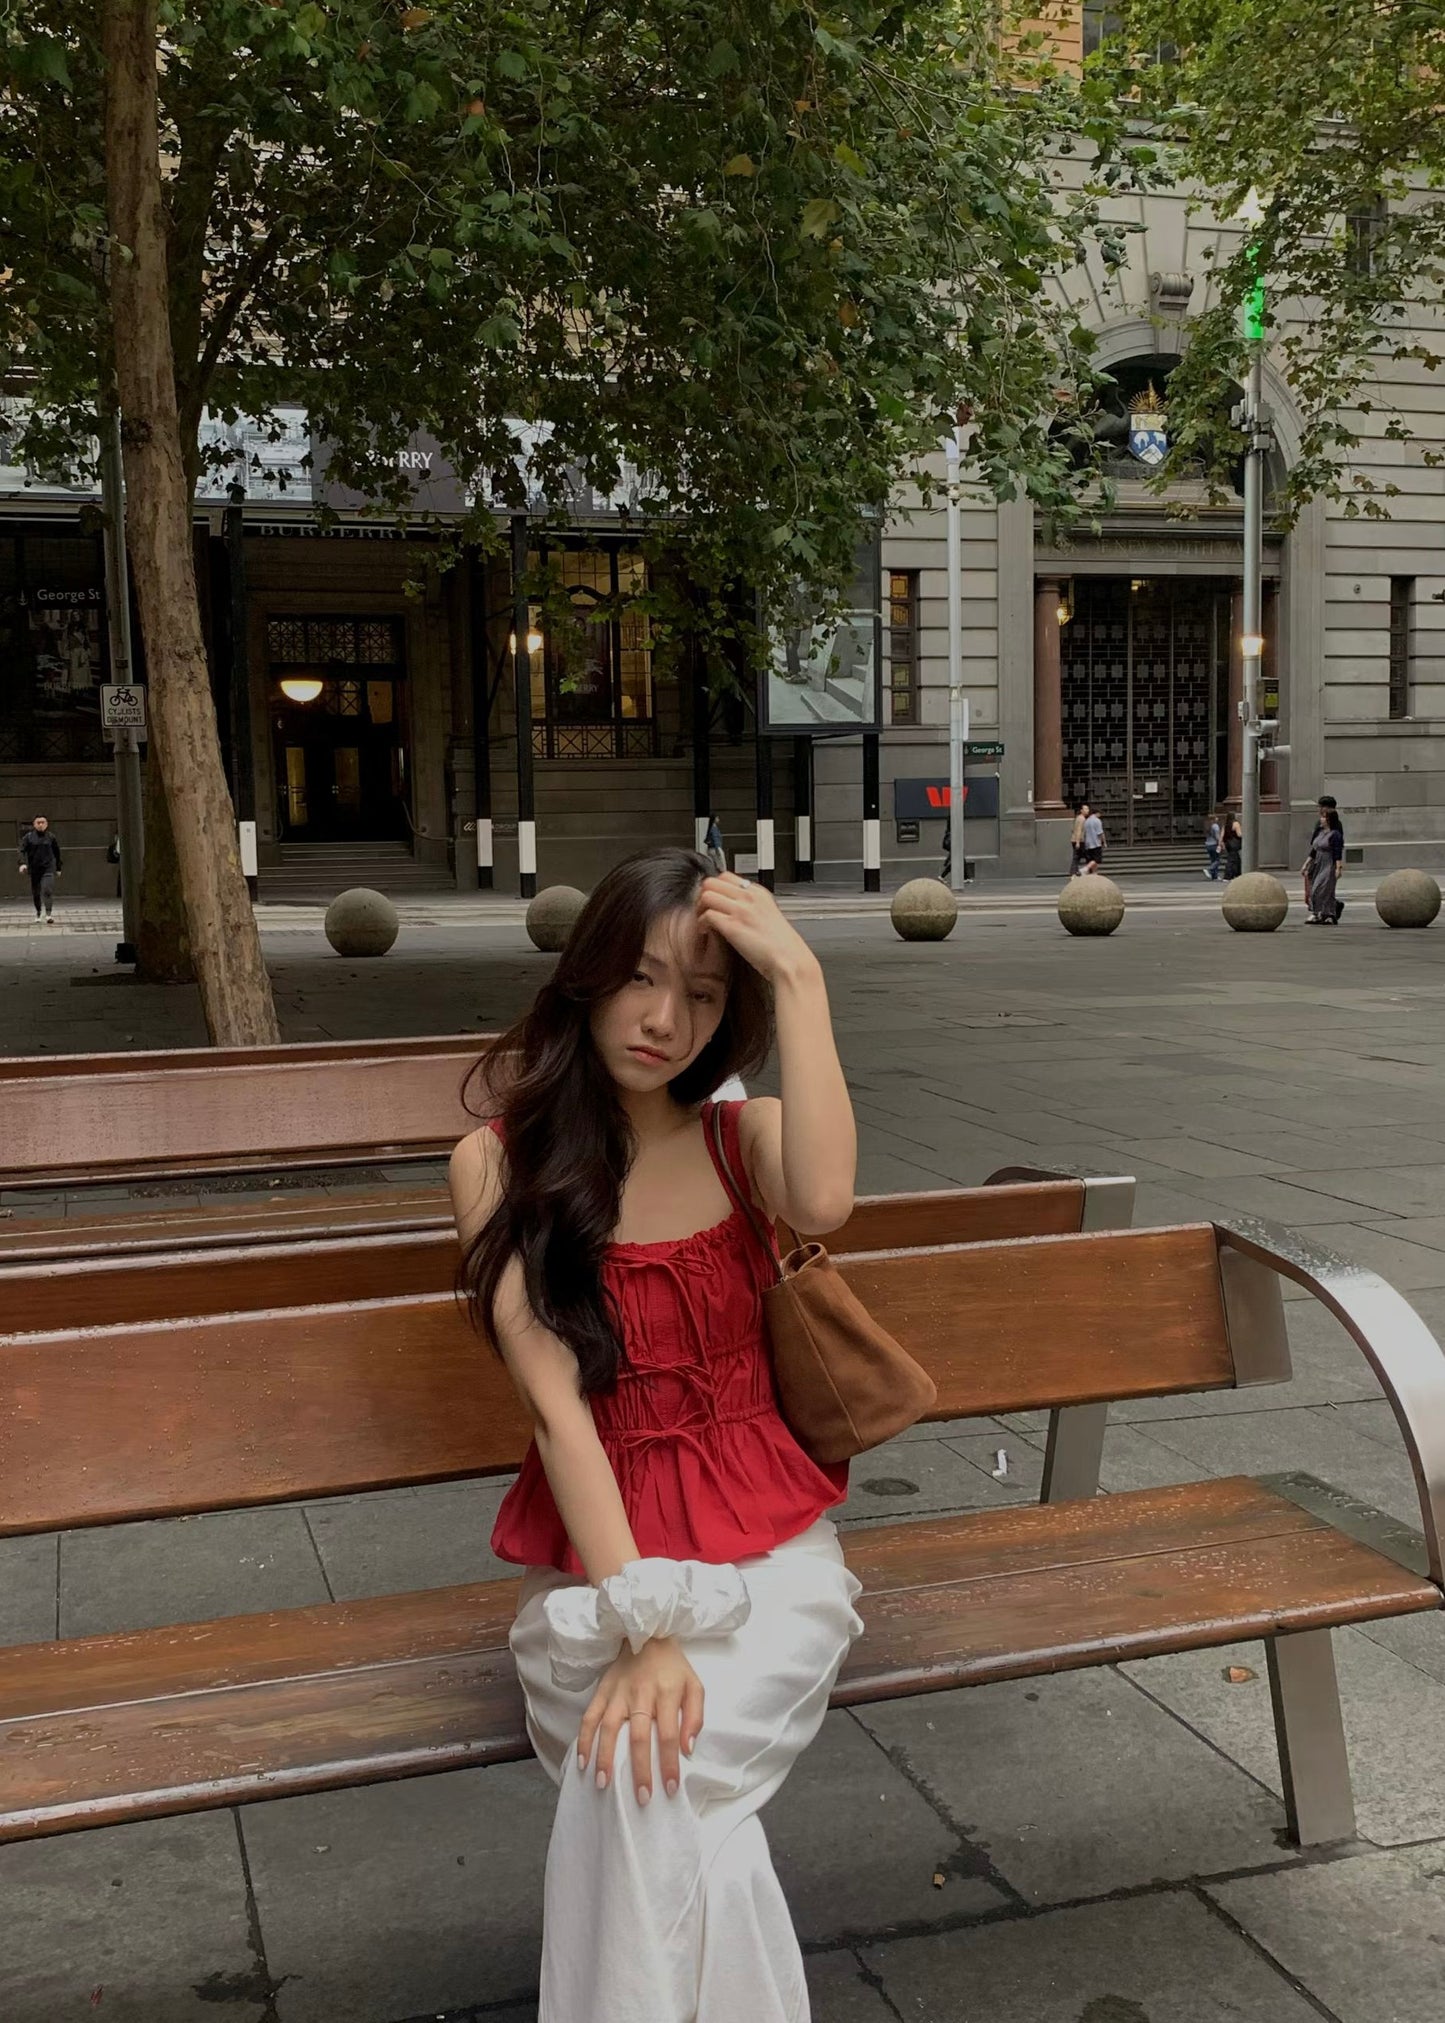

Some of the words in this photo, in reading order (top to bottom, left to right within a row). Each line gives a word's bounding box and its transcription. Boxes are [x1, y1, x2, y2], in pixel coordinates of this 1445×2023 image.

[260, 525, 408, 539] BURBERRY
[37, 589, 85, 603] George
[88, 588, 101, 600] St
[972, 746, 995, 755] George
